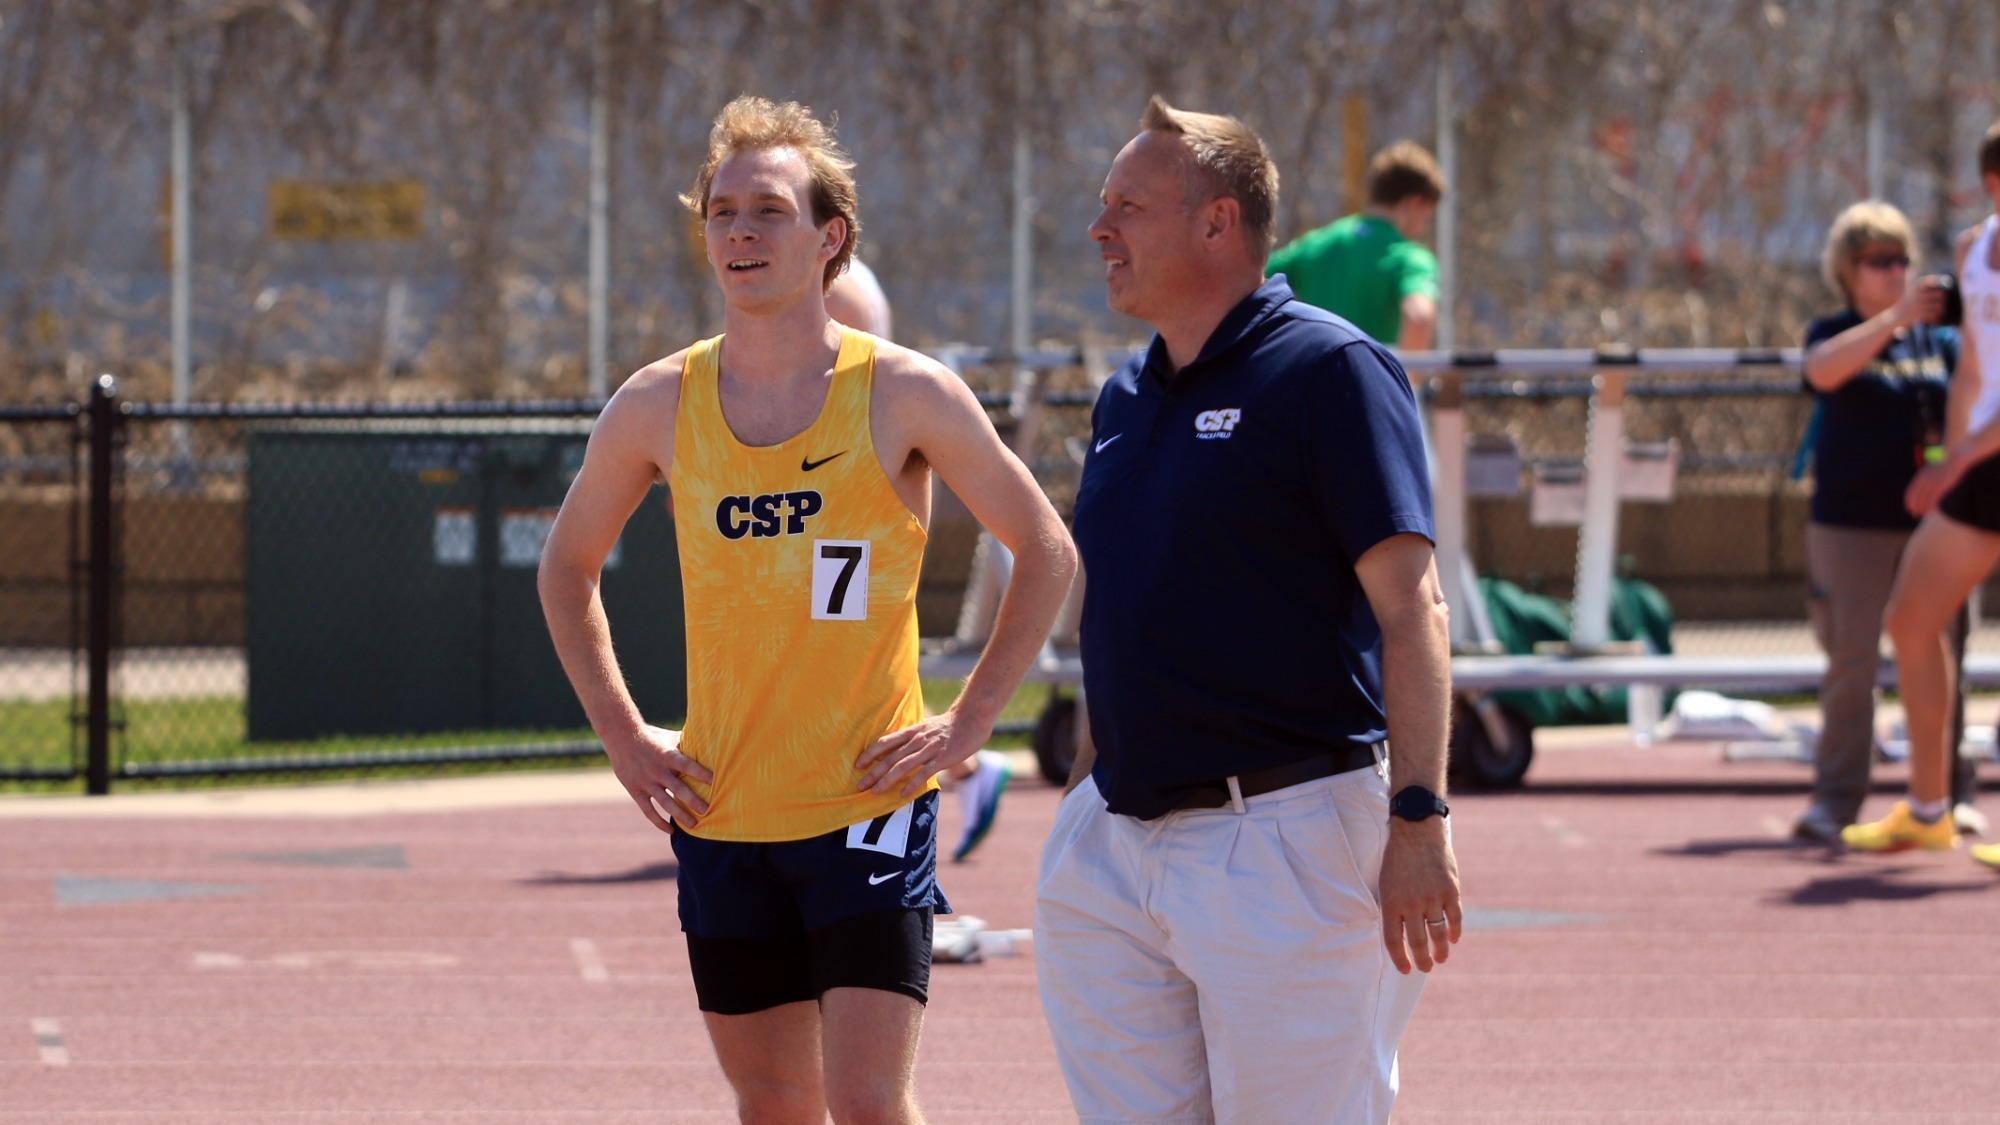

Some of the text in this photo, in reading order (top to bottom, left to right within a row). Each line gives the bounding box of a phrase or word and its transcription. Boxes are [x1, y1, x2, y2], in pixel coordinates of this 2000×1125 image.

[1194, 408, 1241, 431] CSP
[715, 489, 823, 541] CSP
[820, 545, 863, 615] 7
